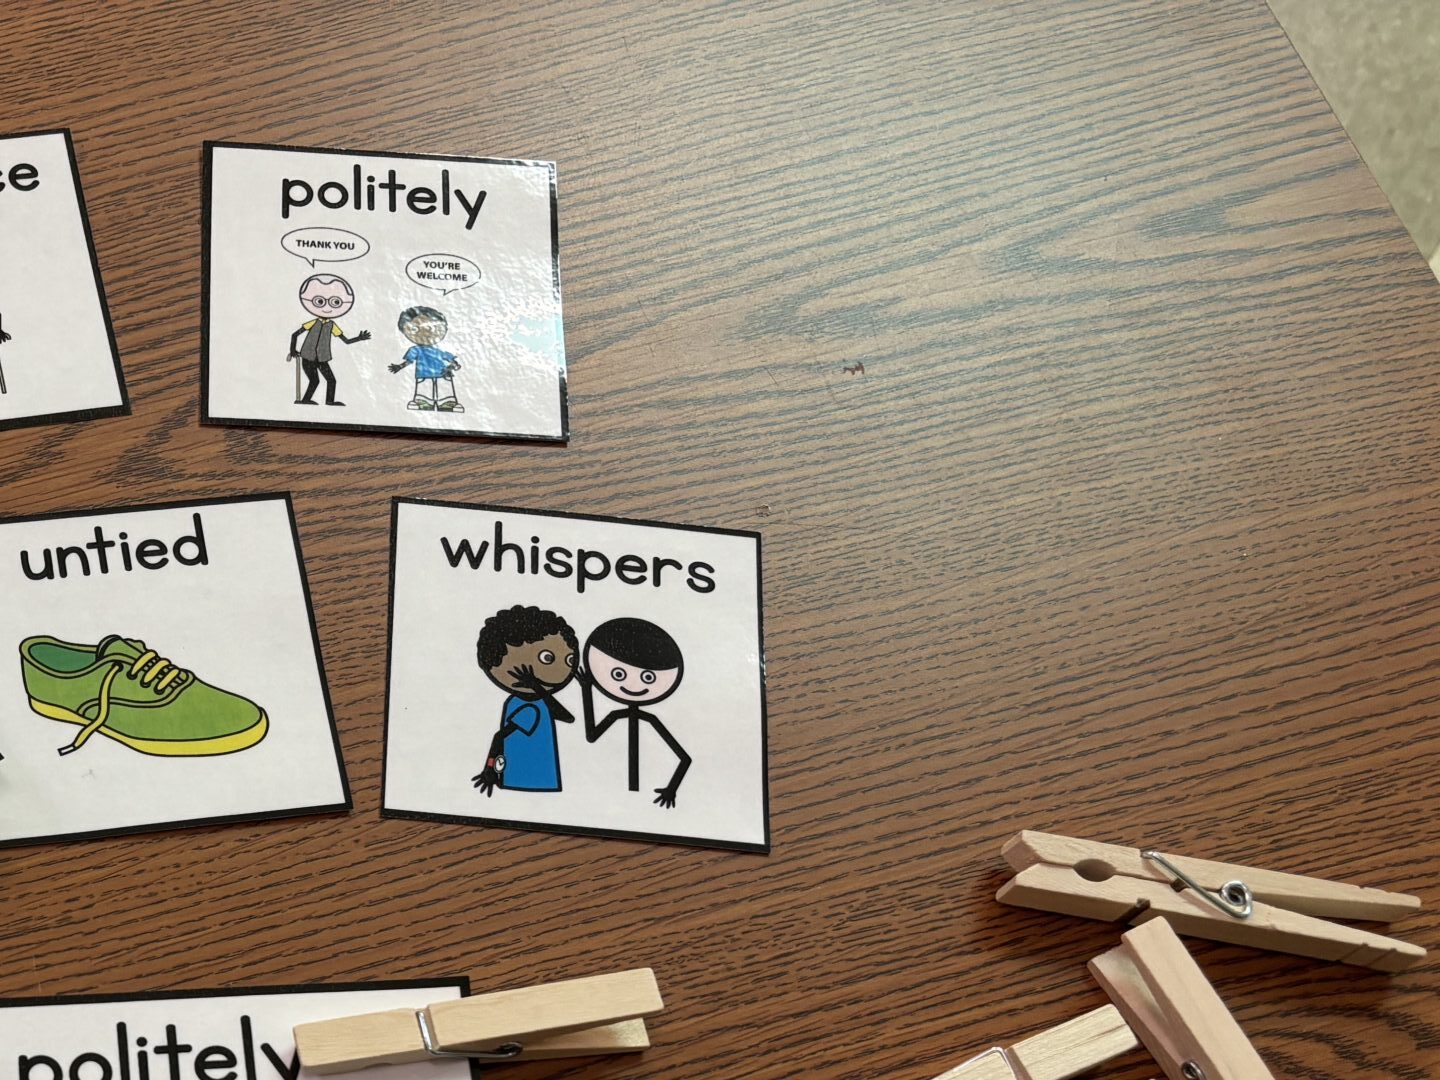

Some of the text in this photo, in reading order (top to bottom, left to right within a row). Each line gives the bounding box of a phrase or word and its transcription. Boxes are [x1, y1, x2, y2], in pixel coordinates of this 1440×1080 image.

[280, 164, 487, 231] politely
[295, 239, 355, 251] THANK YOU
[416, 270, 468, 282] WELCOME
[20, 513, 209, 581] untied
[440, 520, 717, 594] whispers
